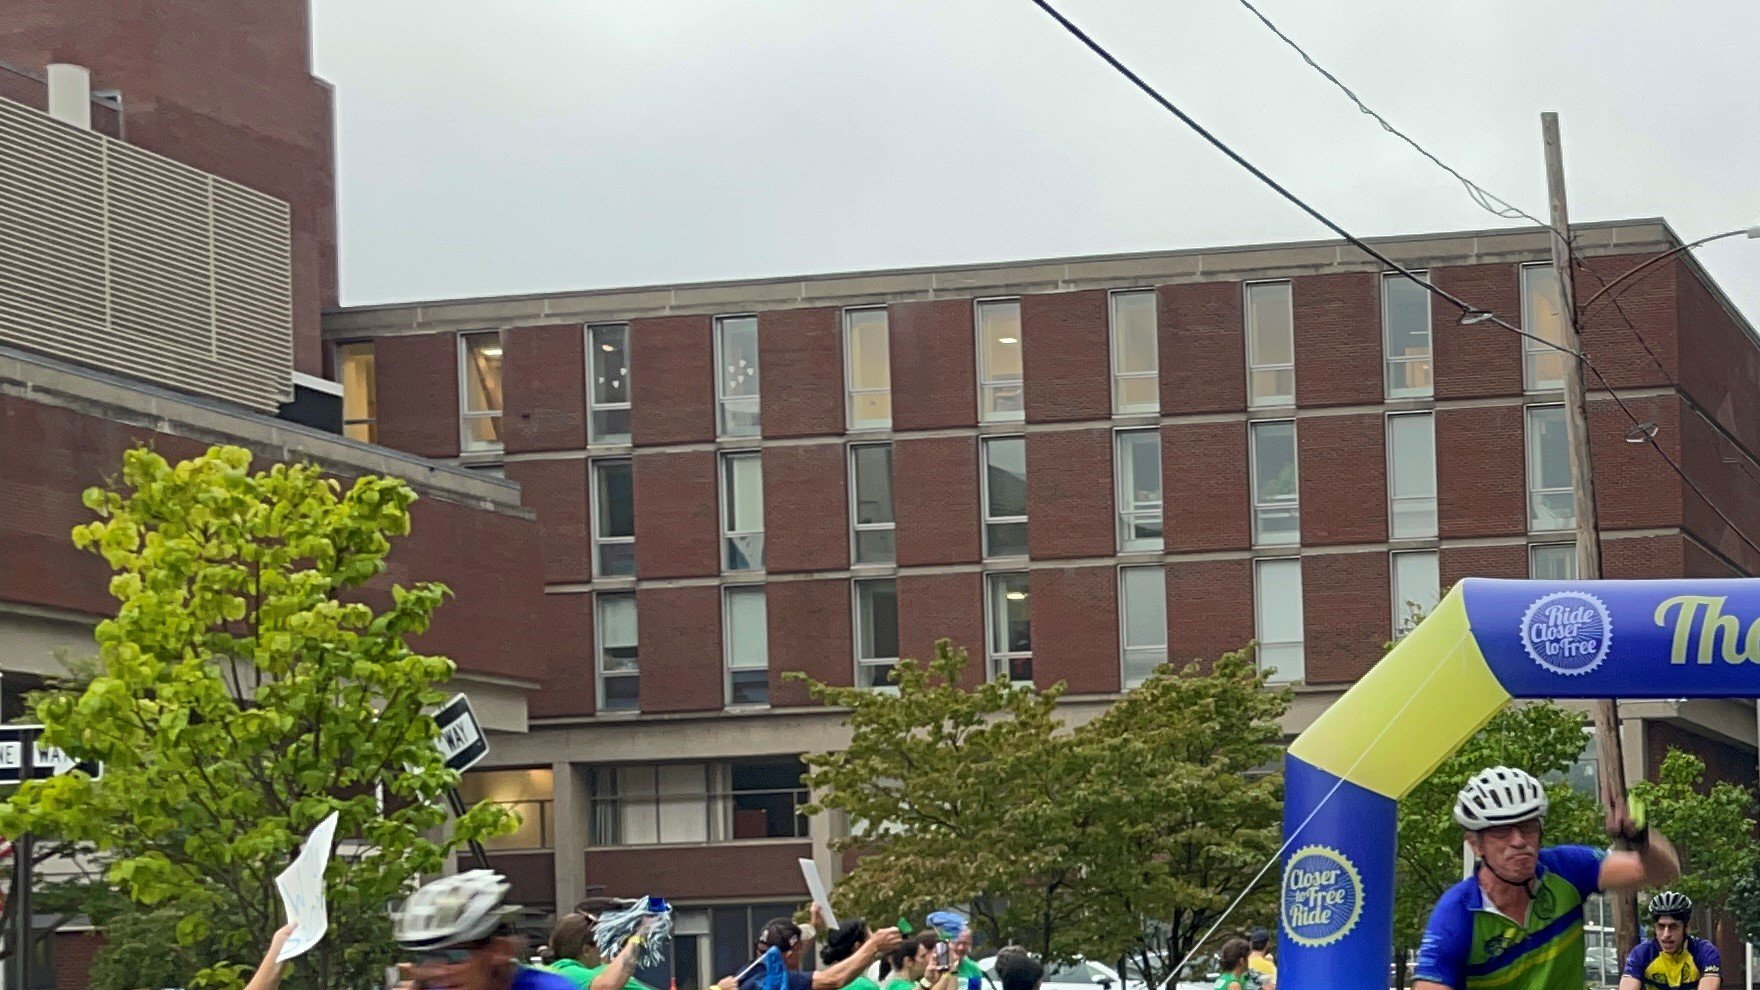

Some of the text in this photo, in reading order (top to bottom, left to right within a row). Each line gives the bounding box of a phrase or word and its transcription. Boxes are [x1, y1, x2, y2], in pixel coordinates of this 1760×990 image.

[1545, 605, 1594, 626] Ride
[1531, 623, 1582, 643] Closer
[1546, 638, 1596, 657] to Free
[444, 721, 468, 752] WAY
[1290, 868, 1341, 890] Closer
[1295, 885, 1346, 907] to Free
[1289, 903, 1332, 928] Ride
